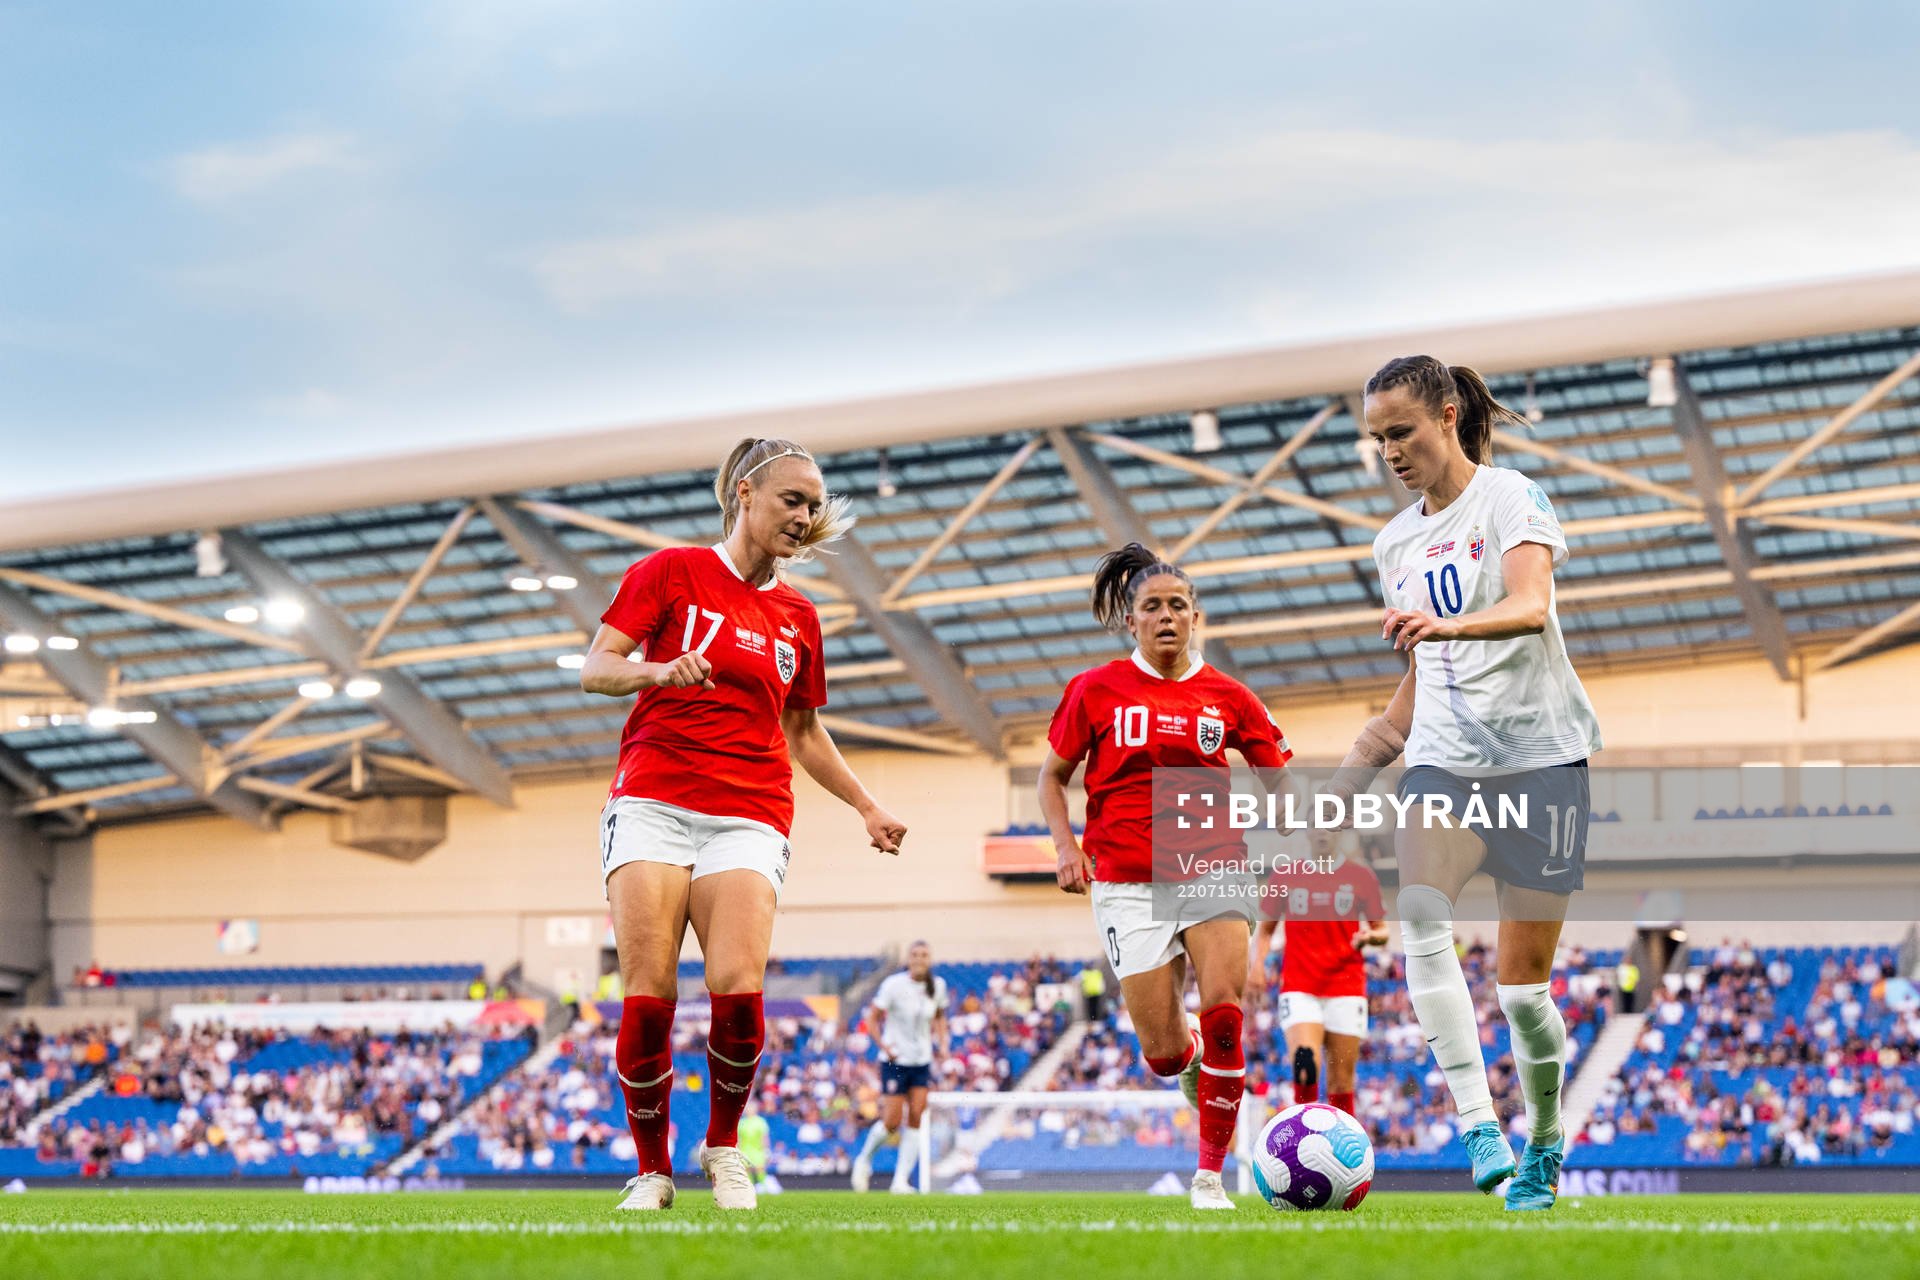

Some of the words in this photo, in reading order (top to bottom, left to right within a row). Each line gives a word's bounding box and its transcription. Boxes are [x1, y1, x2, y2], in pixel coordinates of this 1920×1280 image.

[1424, 563, 1463, 618] 10
[681, 604, 726, 656] 17
[1113, 705, 1149, 748] 10
[1546, 805, 1577, 859] 10
